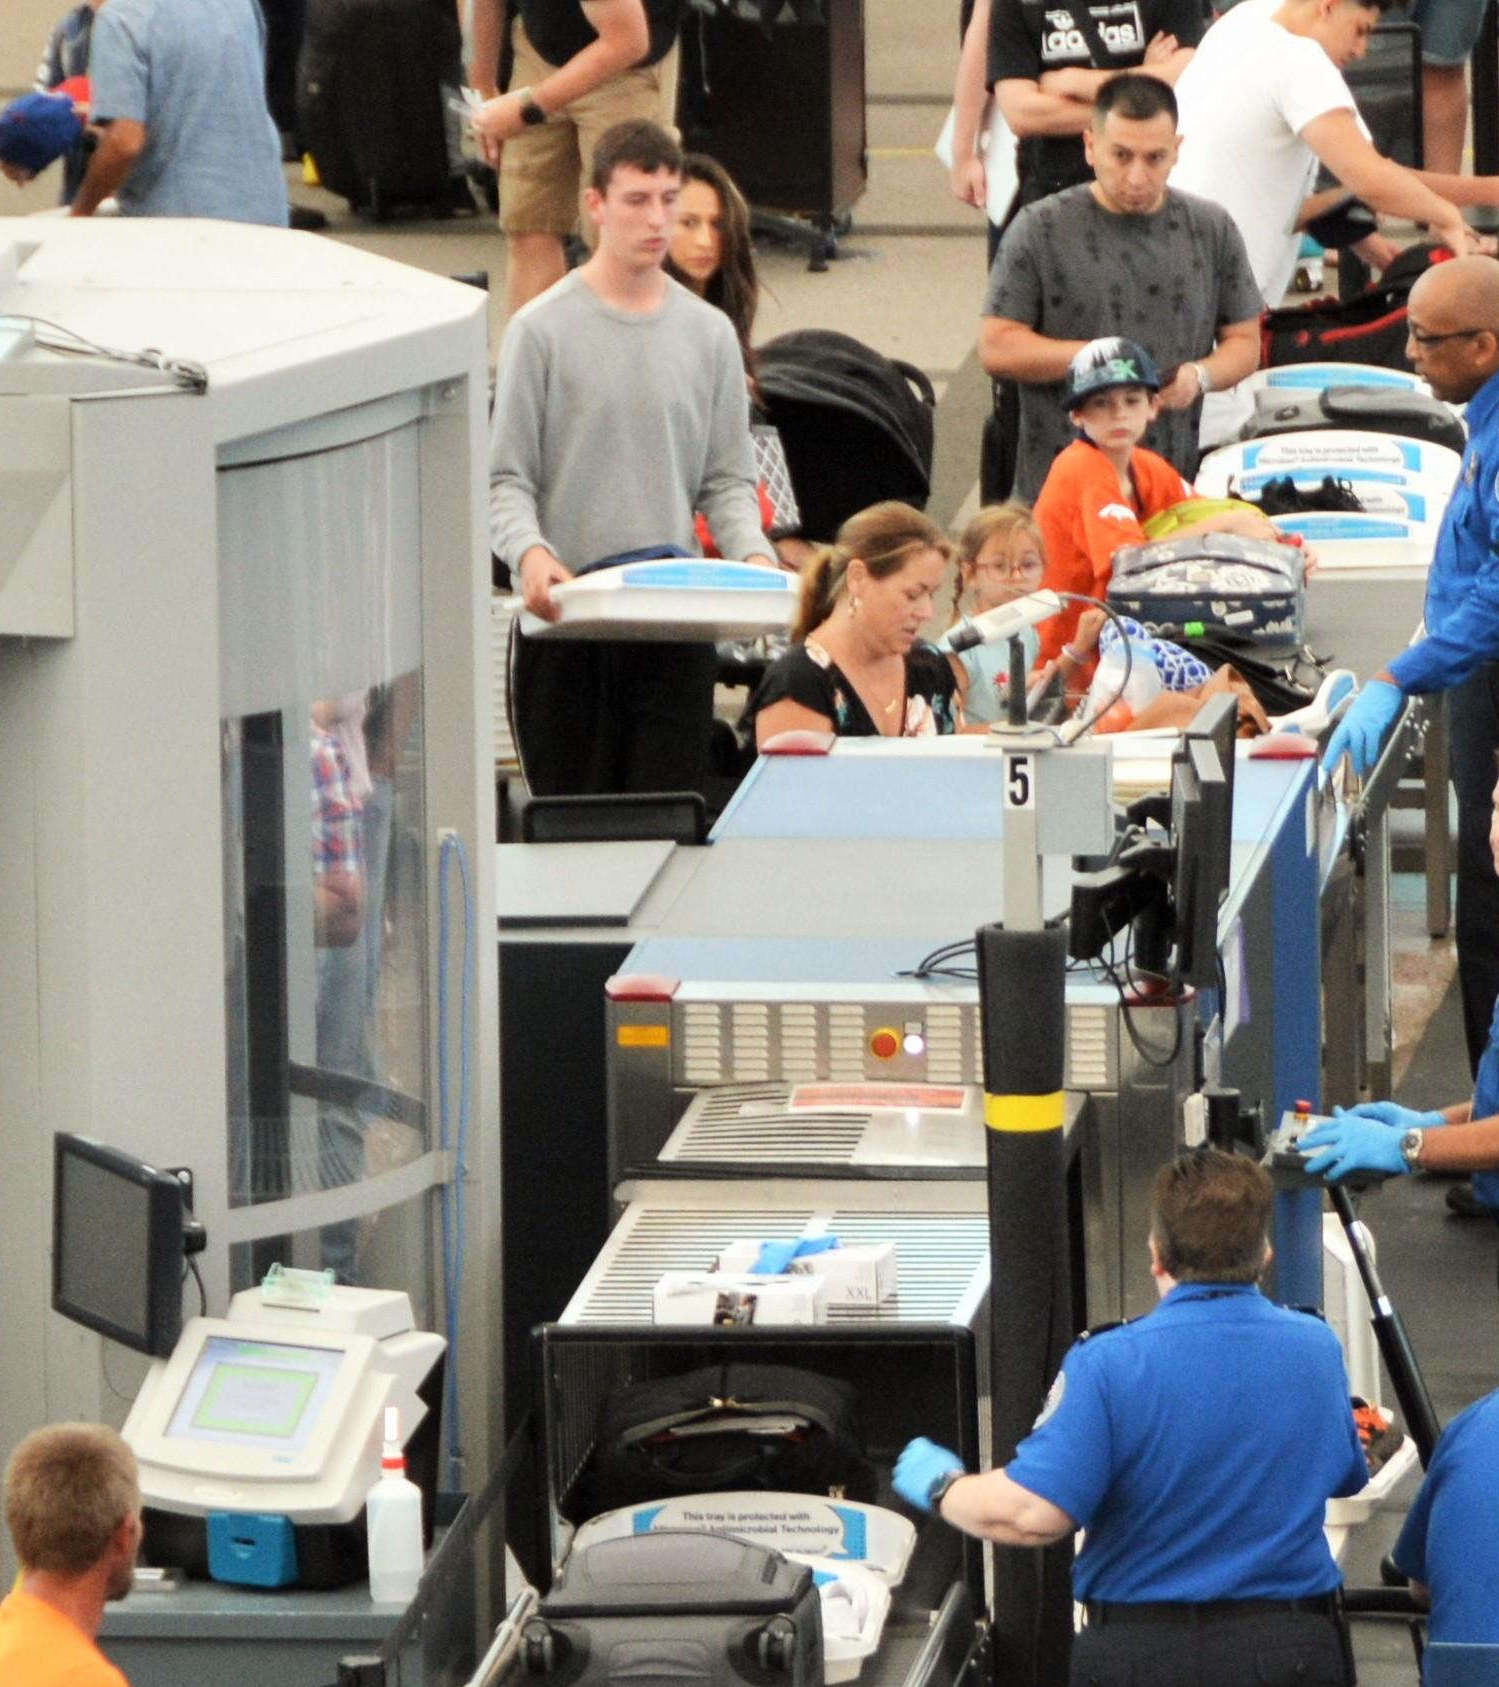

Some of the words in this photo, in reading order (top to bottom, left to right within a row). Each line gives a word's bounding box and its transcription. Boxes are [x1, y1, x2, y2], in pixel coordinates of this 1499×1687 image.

[1009, 756, 1030, 807] 5
[682, 1511, 702, 1521] This
[705, 1512, 724, 1524] tray
[727, 1511, 736, 1521] is
[737, 1511, 787, 1524] protected
[788, 1512, 811, 1521] with
